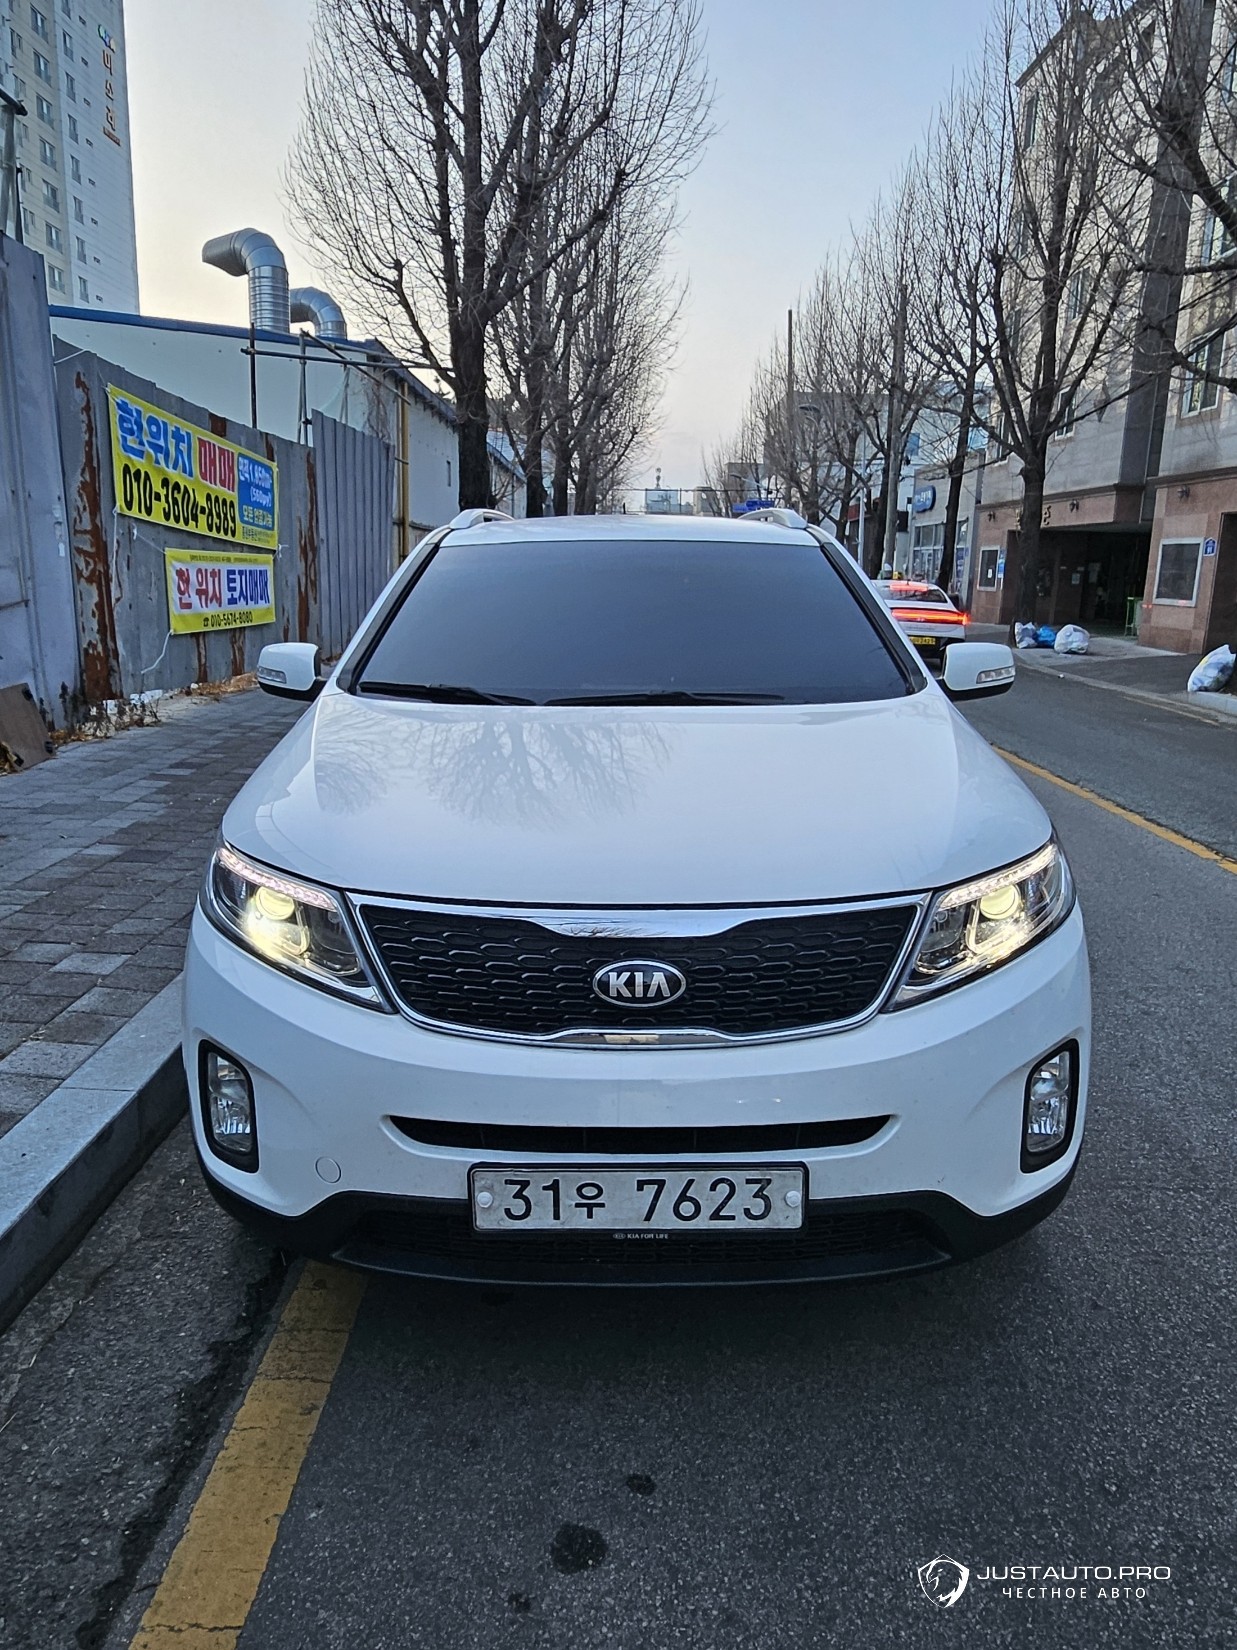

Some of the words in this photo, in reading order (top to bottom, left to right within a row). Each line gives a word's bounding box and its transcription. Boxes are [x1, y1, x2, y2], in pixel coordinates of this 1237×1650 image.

[115, 397, 194, 478] 현위치
[197, 437, 236, 493] 매매
[122, 463, 237, 538] 010-3604-8989
[175, 567, 193, 610] 현
[195, 567, 223, 609] 위치
[226, 568, 270, 606] 토지매매
[608, 971, 671, 998] KIA
[503, 1178, 606, 1222] 31우
[636, 1177, 773, 1222] 7623
